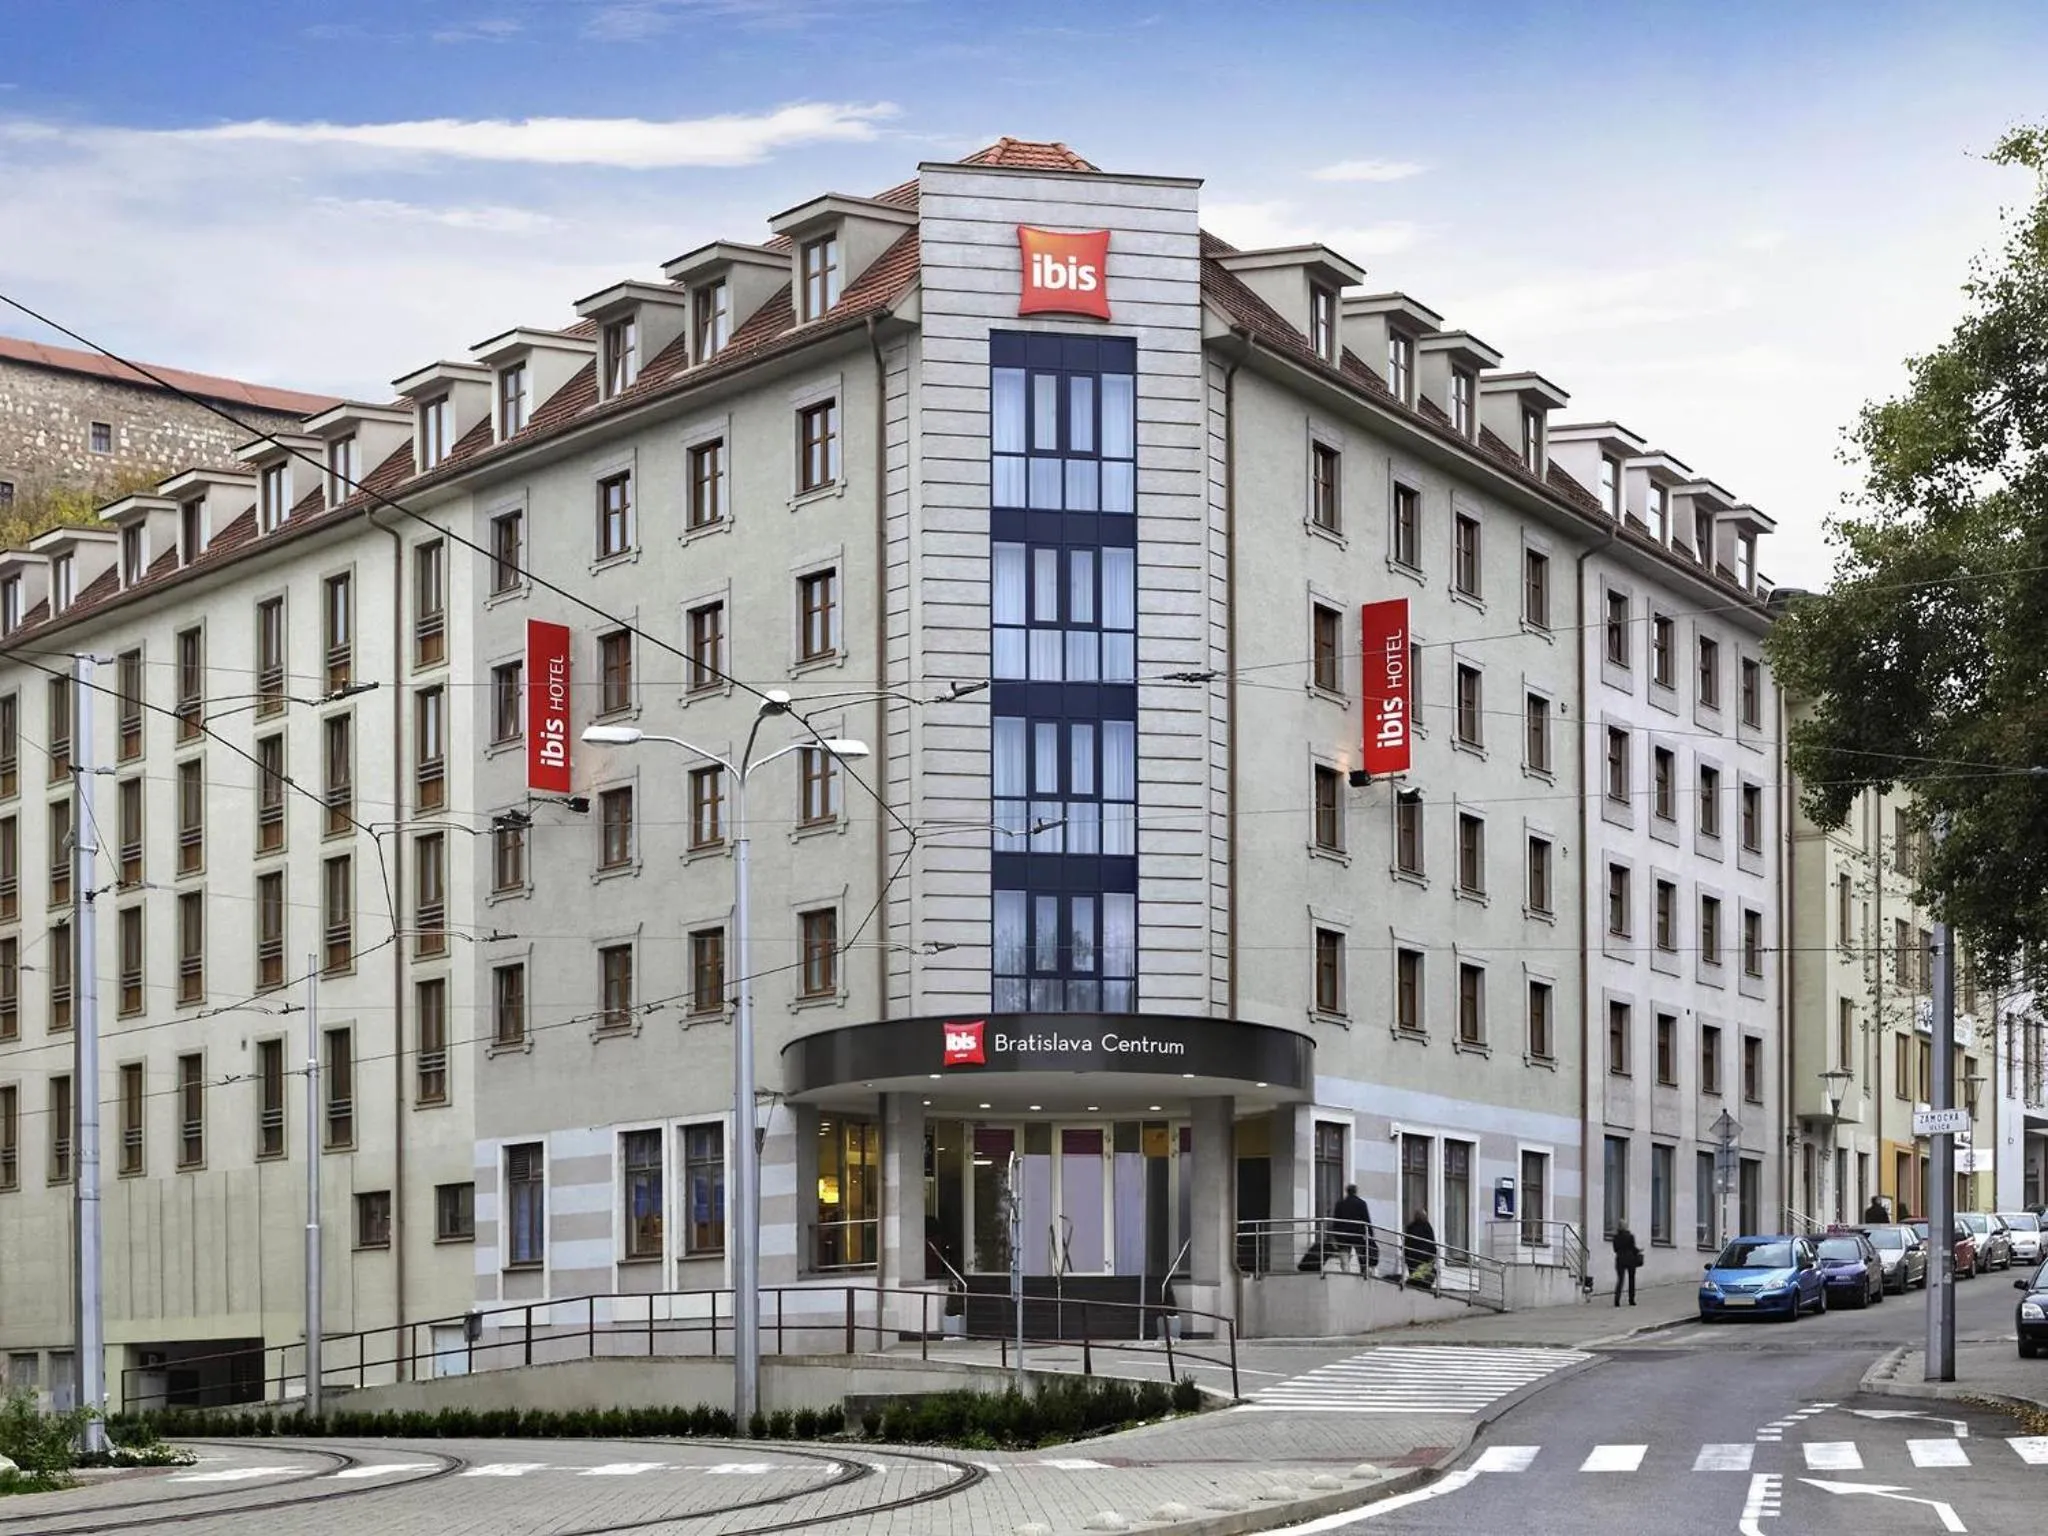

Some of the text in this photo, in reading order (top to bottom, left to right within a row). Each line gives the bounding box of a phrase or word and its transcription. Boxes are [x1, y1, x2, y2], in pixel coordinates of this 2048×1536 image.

[1032, 253, 1097, 291] ibis
[1377, 628, 1403, 748] ibis HOTEL
[540, 655, 565, 767] ibis HOTEL
[946, 1032, 976, 1051] ibis
[994, 1032, 1184, 1055] Bratislava Centrum
